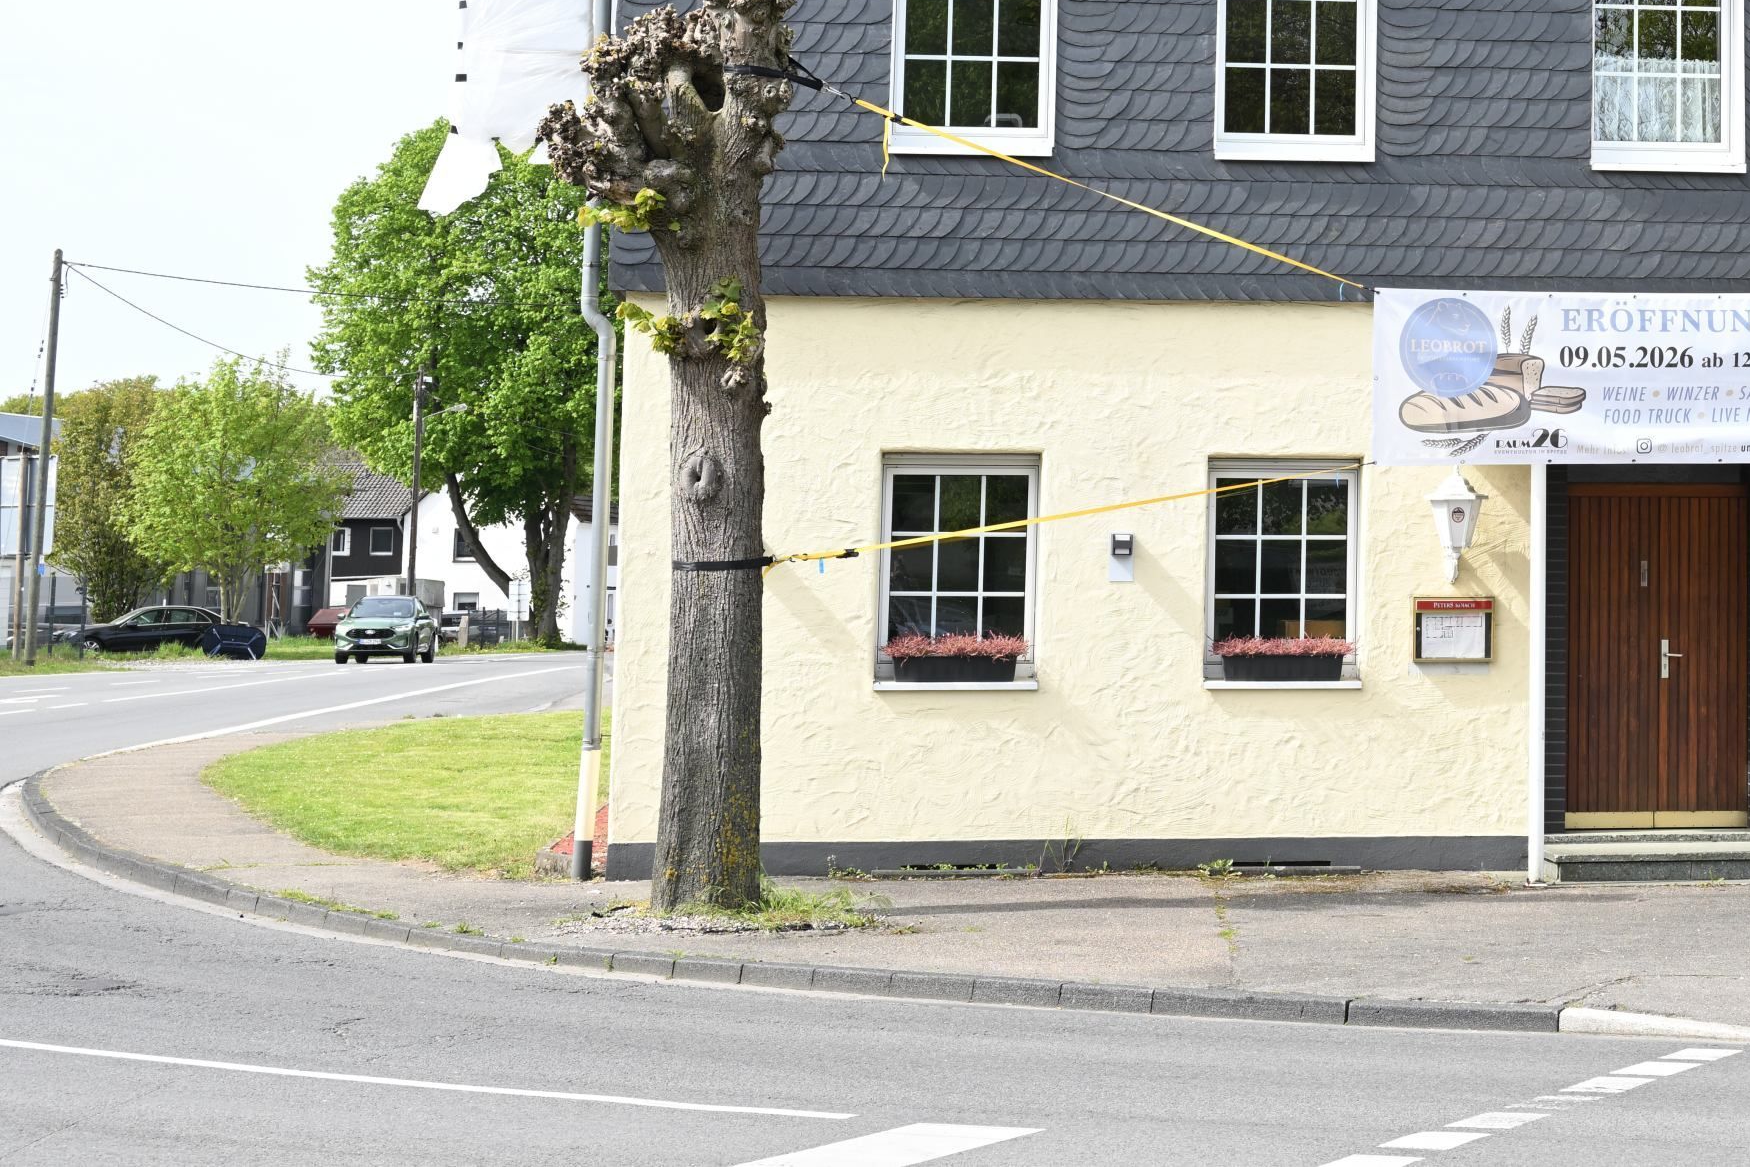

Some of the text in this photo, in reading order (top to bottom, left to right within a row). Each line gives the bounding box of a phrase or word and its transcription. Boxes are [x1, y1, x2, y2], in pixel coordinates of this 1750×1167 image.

[1410, 338, 1487, 354] LEOBROT
[1559, 345, 1694, 369] 09.05.2026
[1701, 352, 1724, 368] ab
[1602, 386, 1648, 402] WEINE
[1667, 386, 1720, 401] WINZER
[1604, 408, 1641, 424] FOOD
[1648, 407, 1692, 424] TRUCK
[1712, 407, 1741, 423] LIVE
